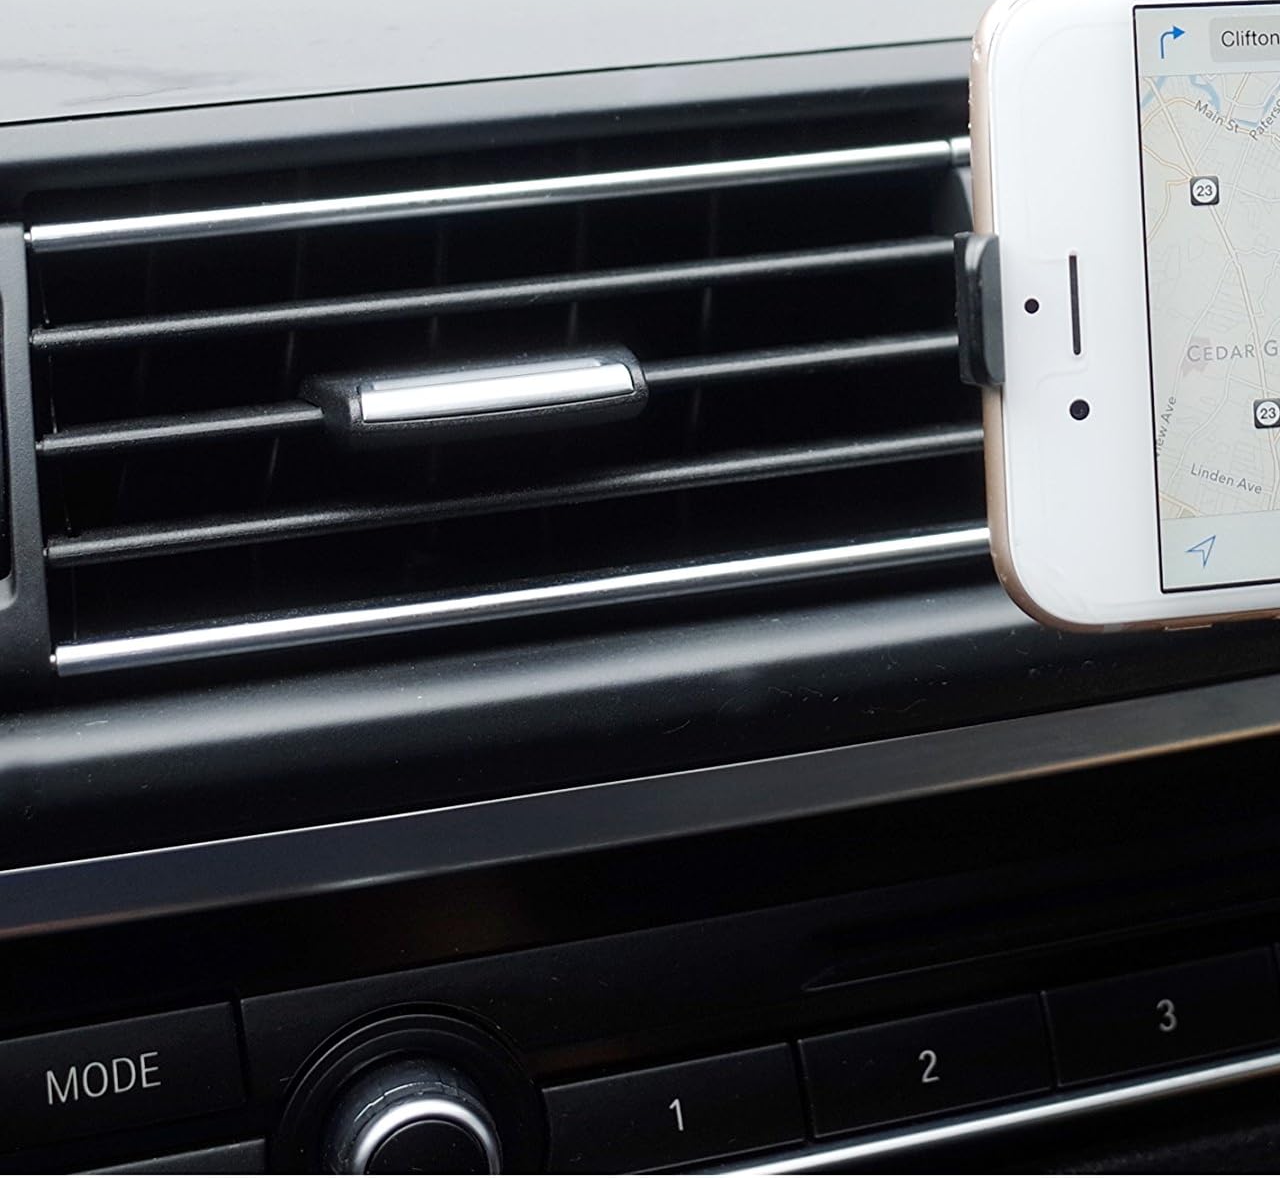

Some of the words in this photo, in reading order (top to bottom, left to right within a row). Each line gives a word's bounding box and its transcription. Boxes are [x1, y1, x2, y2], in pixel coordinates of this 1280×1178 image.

[1194, 99, 1225, 126] Main
[1225, 118, 1240, 134] St
[1196, 184, 1213, 197] 23
[1186, 344, 1256, 363] CEDAR
[1160, 396, 1178, 425] Ave
[1259, 407, 1277, 420] 23
[1190, 463, 1234, 487] Linden
[1236, 478, 1263, 494] Ave
[1156, 998, 1178, 1033] 3
[46, 1051, 162, 1105] MODE
[918, 1049, 941, 1084] 2
[668, 1097, 685, 1132] 1
